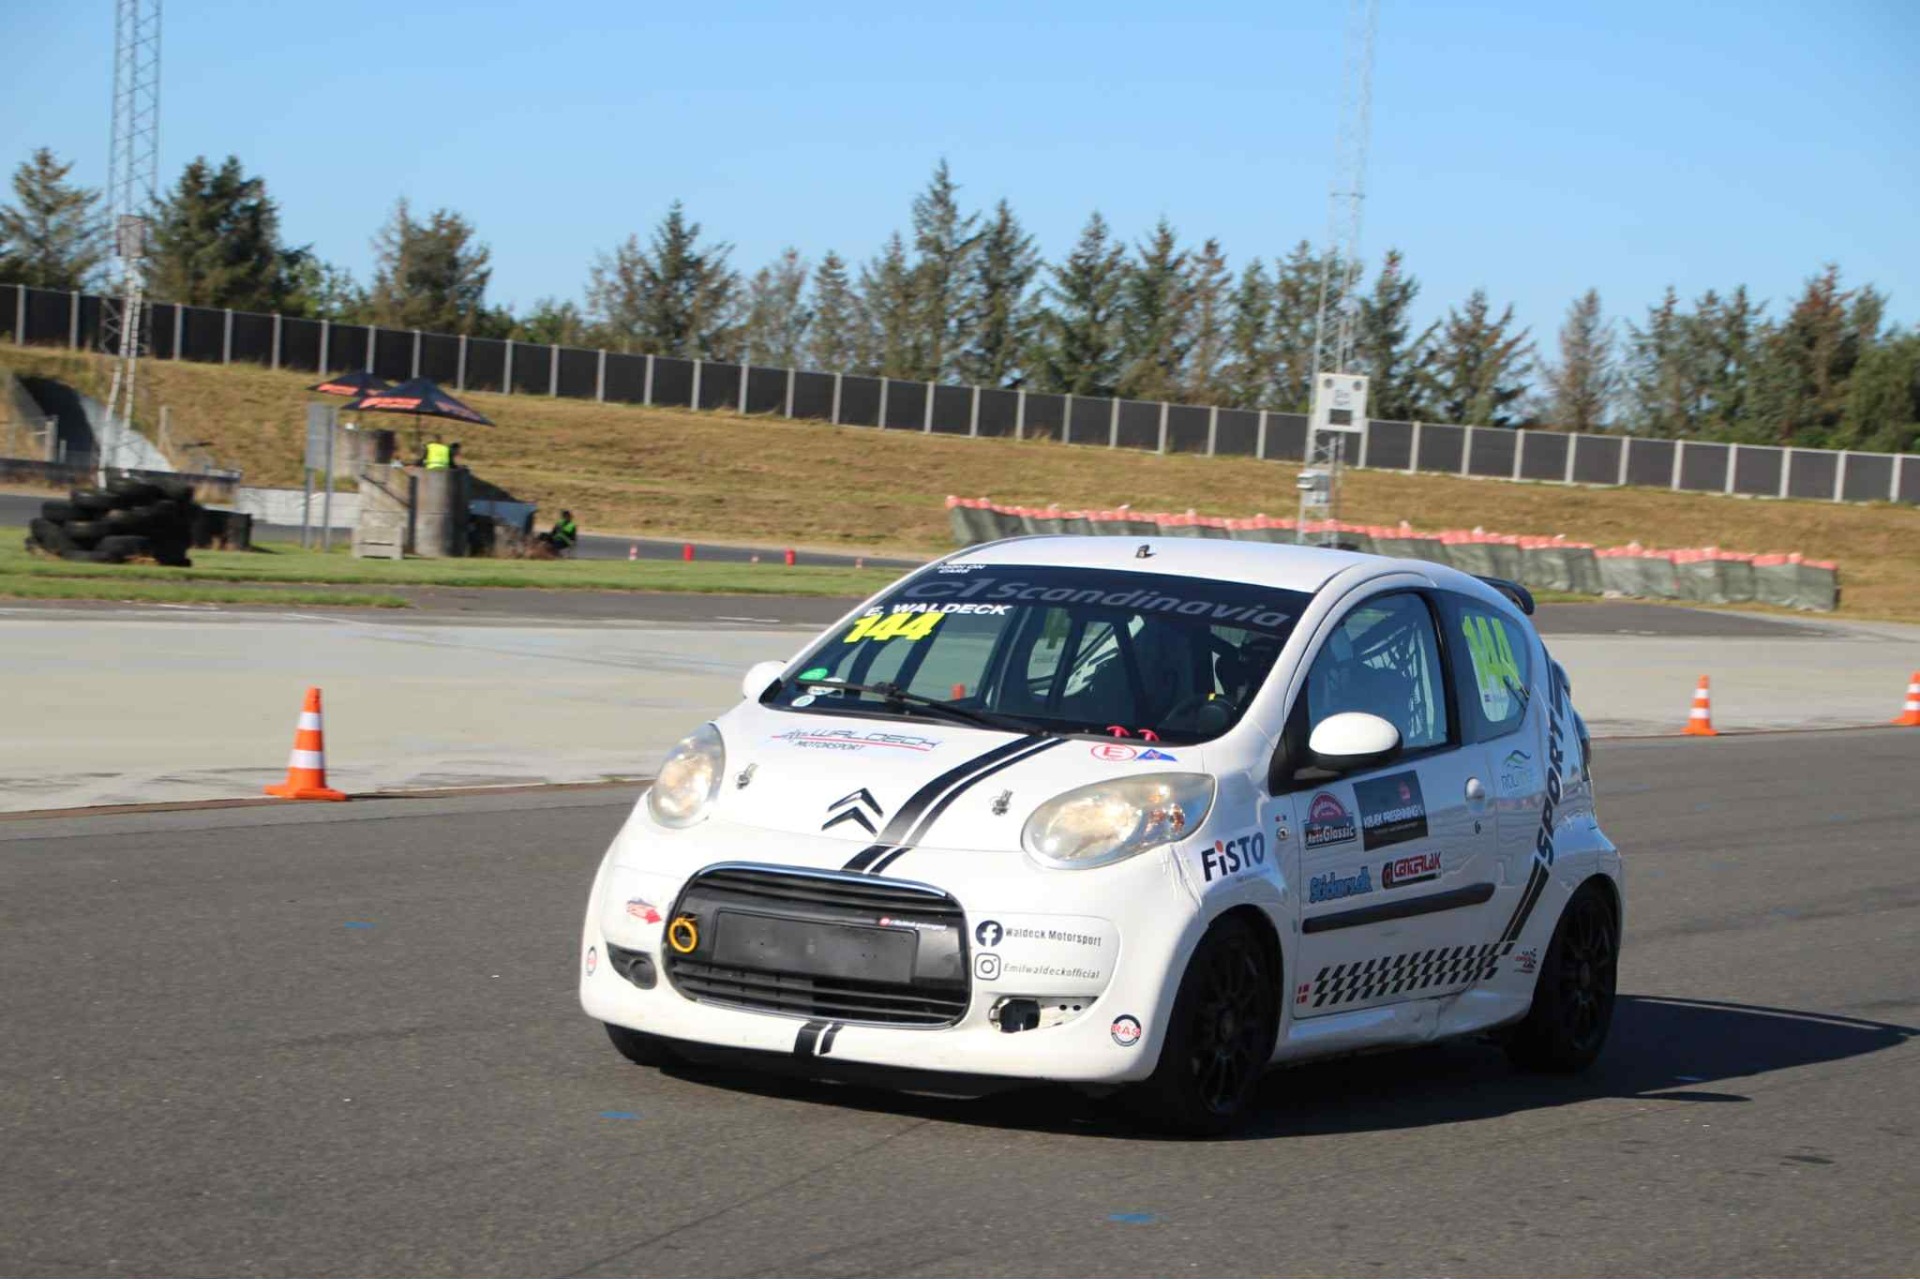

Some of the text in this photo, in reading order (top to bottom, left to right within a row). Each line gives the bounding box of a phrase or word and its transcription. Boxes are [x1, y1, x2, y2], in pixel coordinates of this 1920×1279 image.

[892, 603, 1013, 616] WALDECK
[985, 582, 1291, 627] Scandinavia
[843, 612, 946, 643] 144
[1005, 928, 1046, 940] Waldeck
[1048, 930, 1102, 947] Motorsport
